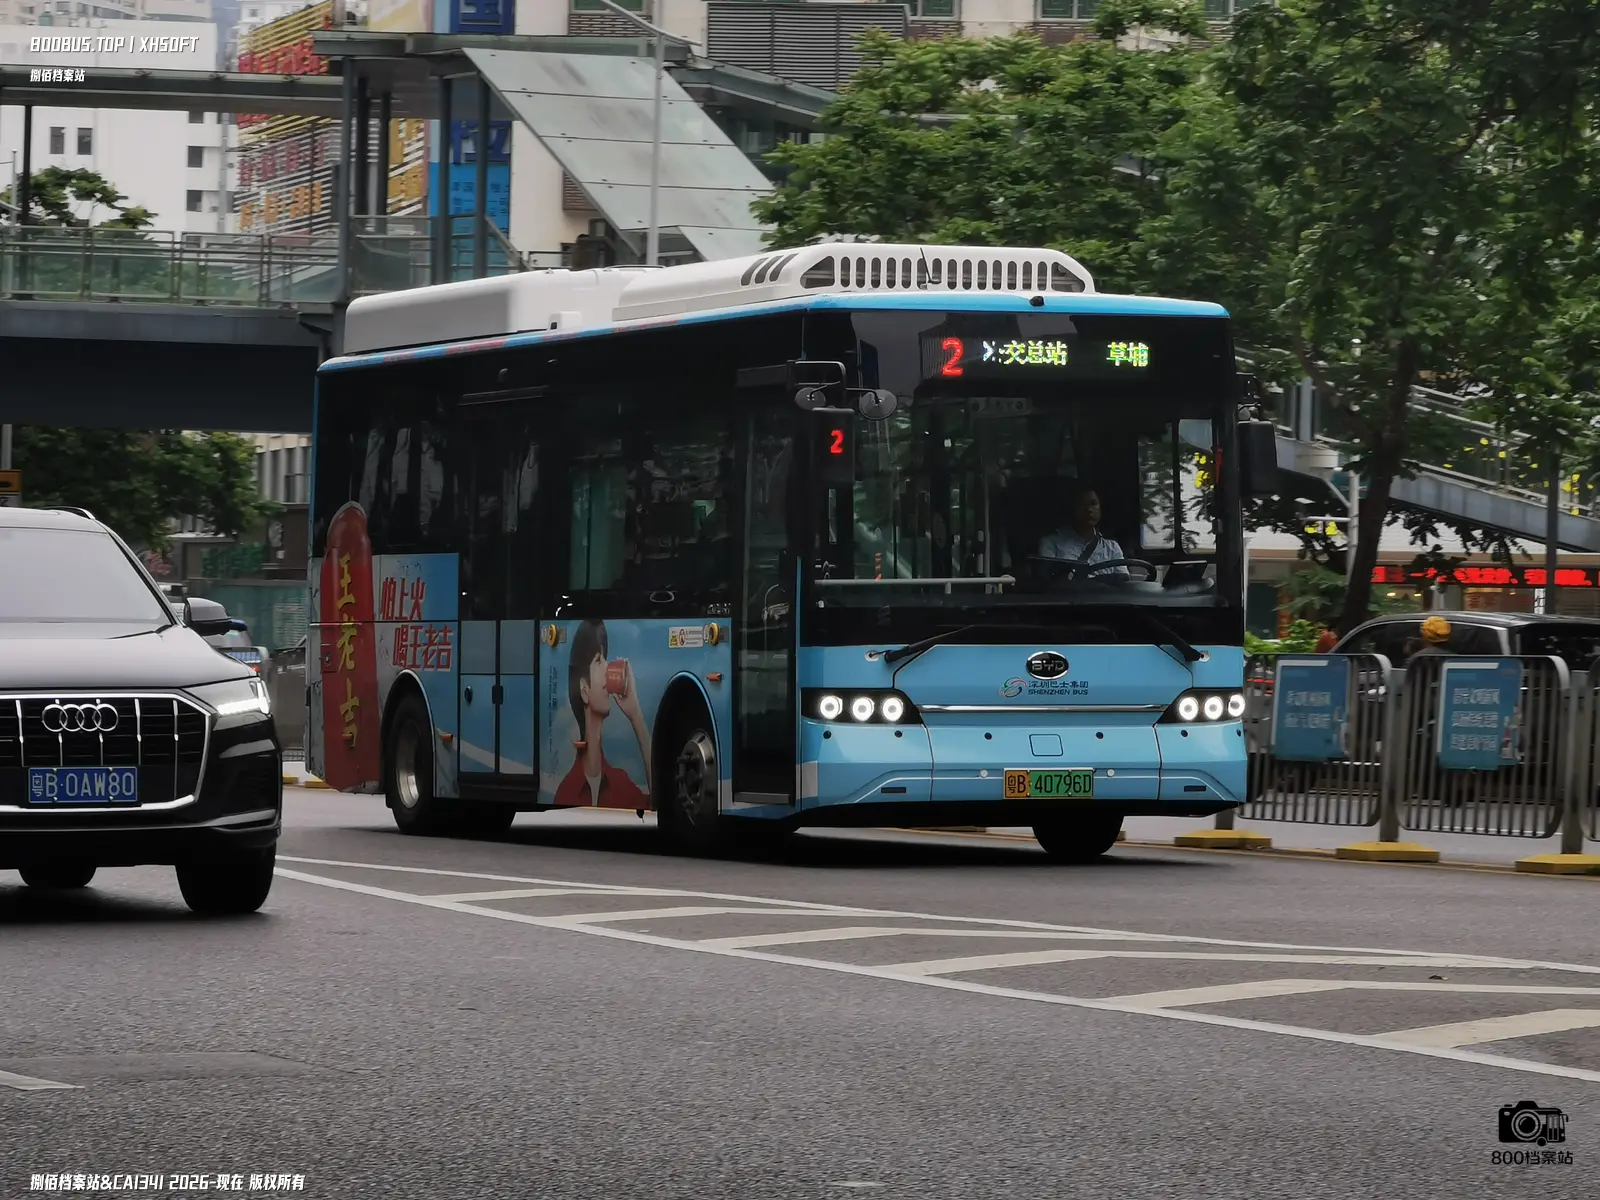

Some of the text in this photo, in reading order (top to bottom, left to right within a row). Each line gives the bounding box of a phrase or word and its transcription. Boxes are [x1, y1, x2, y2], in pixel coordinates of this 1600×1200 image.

[942, 337, 964, 376] 2
[830, 429, 844, 454] 2
[380, 577, 425, 621] 怕上火
[392, 625, 453, 669] 喝王老吉
[1031, 660, 1065, 671] BYD
[1028, 680, 1089, 689] 深圳巴士集团
